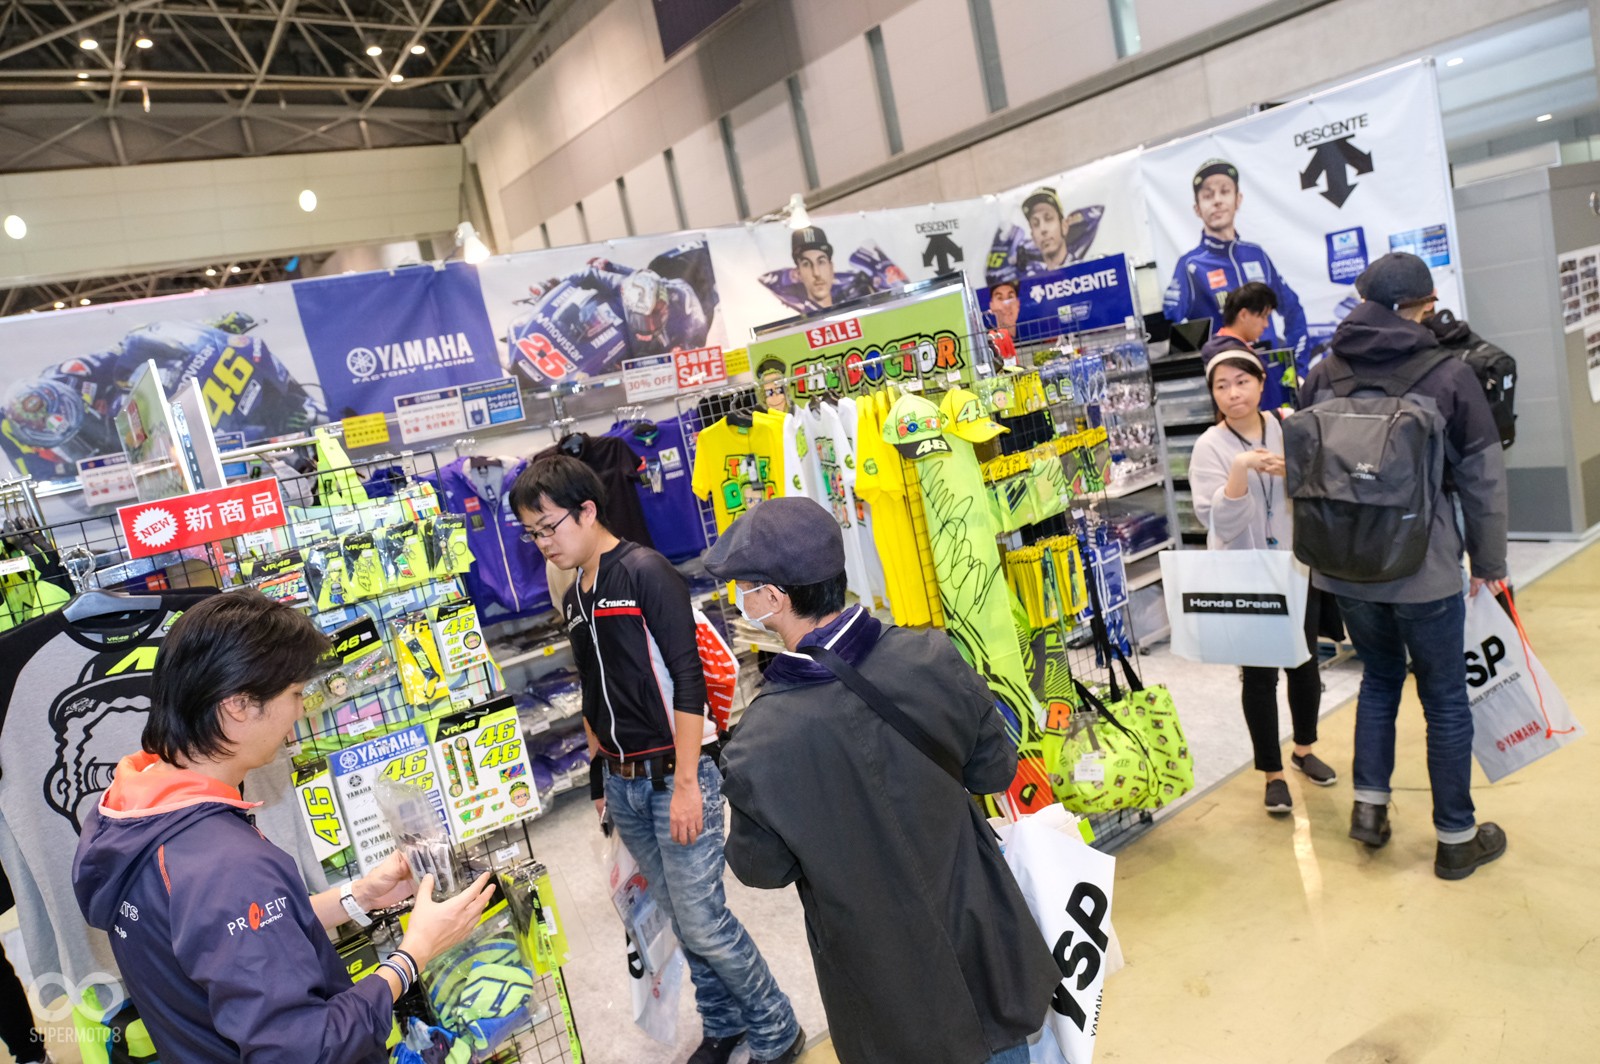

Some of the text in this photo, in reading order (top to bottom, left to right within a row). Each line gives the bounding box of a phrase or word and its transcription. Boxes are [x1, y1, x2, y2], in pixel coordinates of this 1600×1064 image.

[1294, 113, 1368, 147] DESCENTE
[915, 219, 960, 234] DESCENTE
[1045, 268, 1119, 300] DESCENTE
[810, 321, 859, 346] SALE
[374, 332, 473, 371] YAMAHA
[352, 357, 475, 384] FACTORY RACING
[629, 375, 674, 391] 30% OFF
[679, 361, 725, 387] SALE
[202, 346, 254, 428] 46
[916, 440, 948, 456] 46
[140, 491, 278, 540] NEW 新商品
[261, 558, 291, 572] VR46
[1190, 598, 1281, 609] Honda Dream
[443, 613, 475, 636] 46
[442, 719, 476, 736] VR46
[475, 719, 516, 748] 46
[1504, 720, 1542, 748] YAMAHA
[357, 730, 419, 763] YAMAHA
[480, 739, 521, 769] 46
[343, 756, 385, 774] FACTORY
[383, 749, 427, 781] 46
[346, 785, 372, 799] YAMAHA
[303, 786, 342, 846] 46
